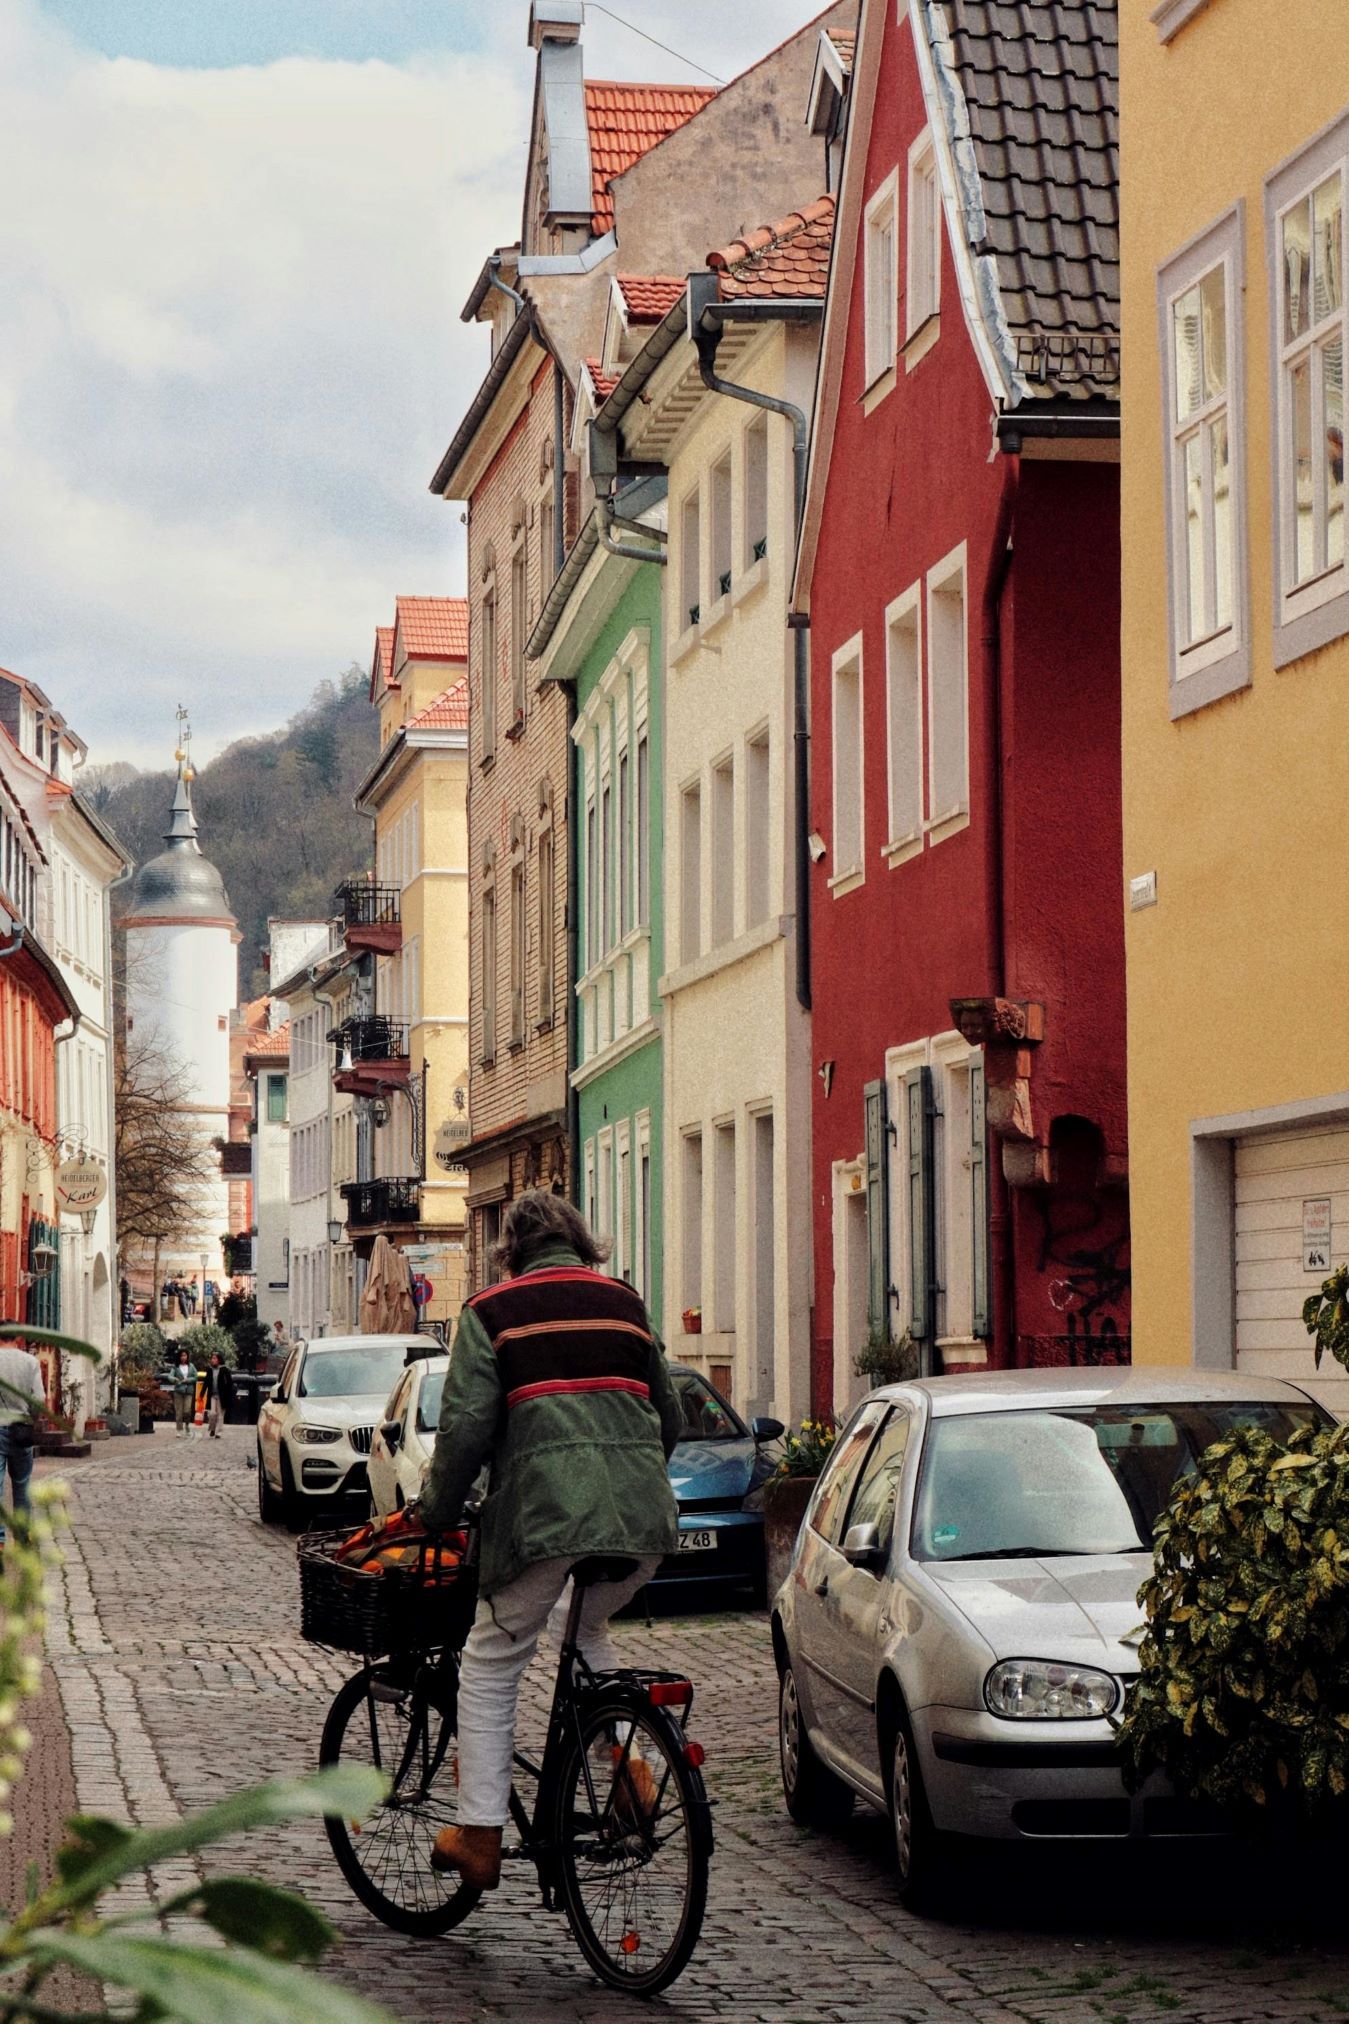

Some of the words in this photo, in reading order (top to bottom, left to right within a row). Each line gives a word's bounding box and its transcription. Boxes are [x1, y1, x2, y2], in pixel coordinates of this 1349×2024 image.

[61, 1174, 99, 1183] HEIDELBERGER
[66, 1186, 97, 1204] Karl
[692, 1532, 711, 1547] 48
